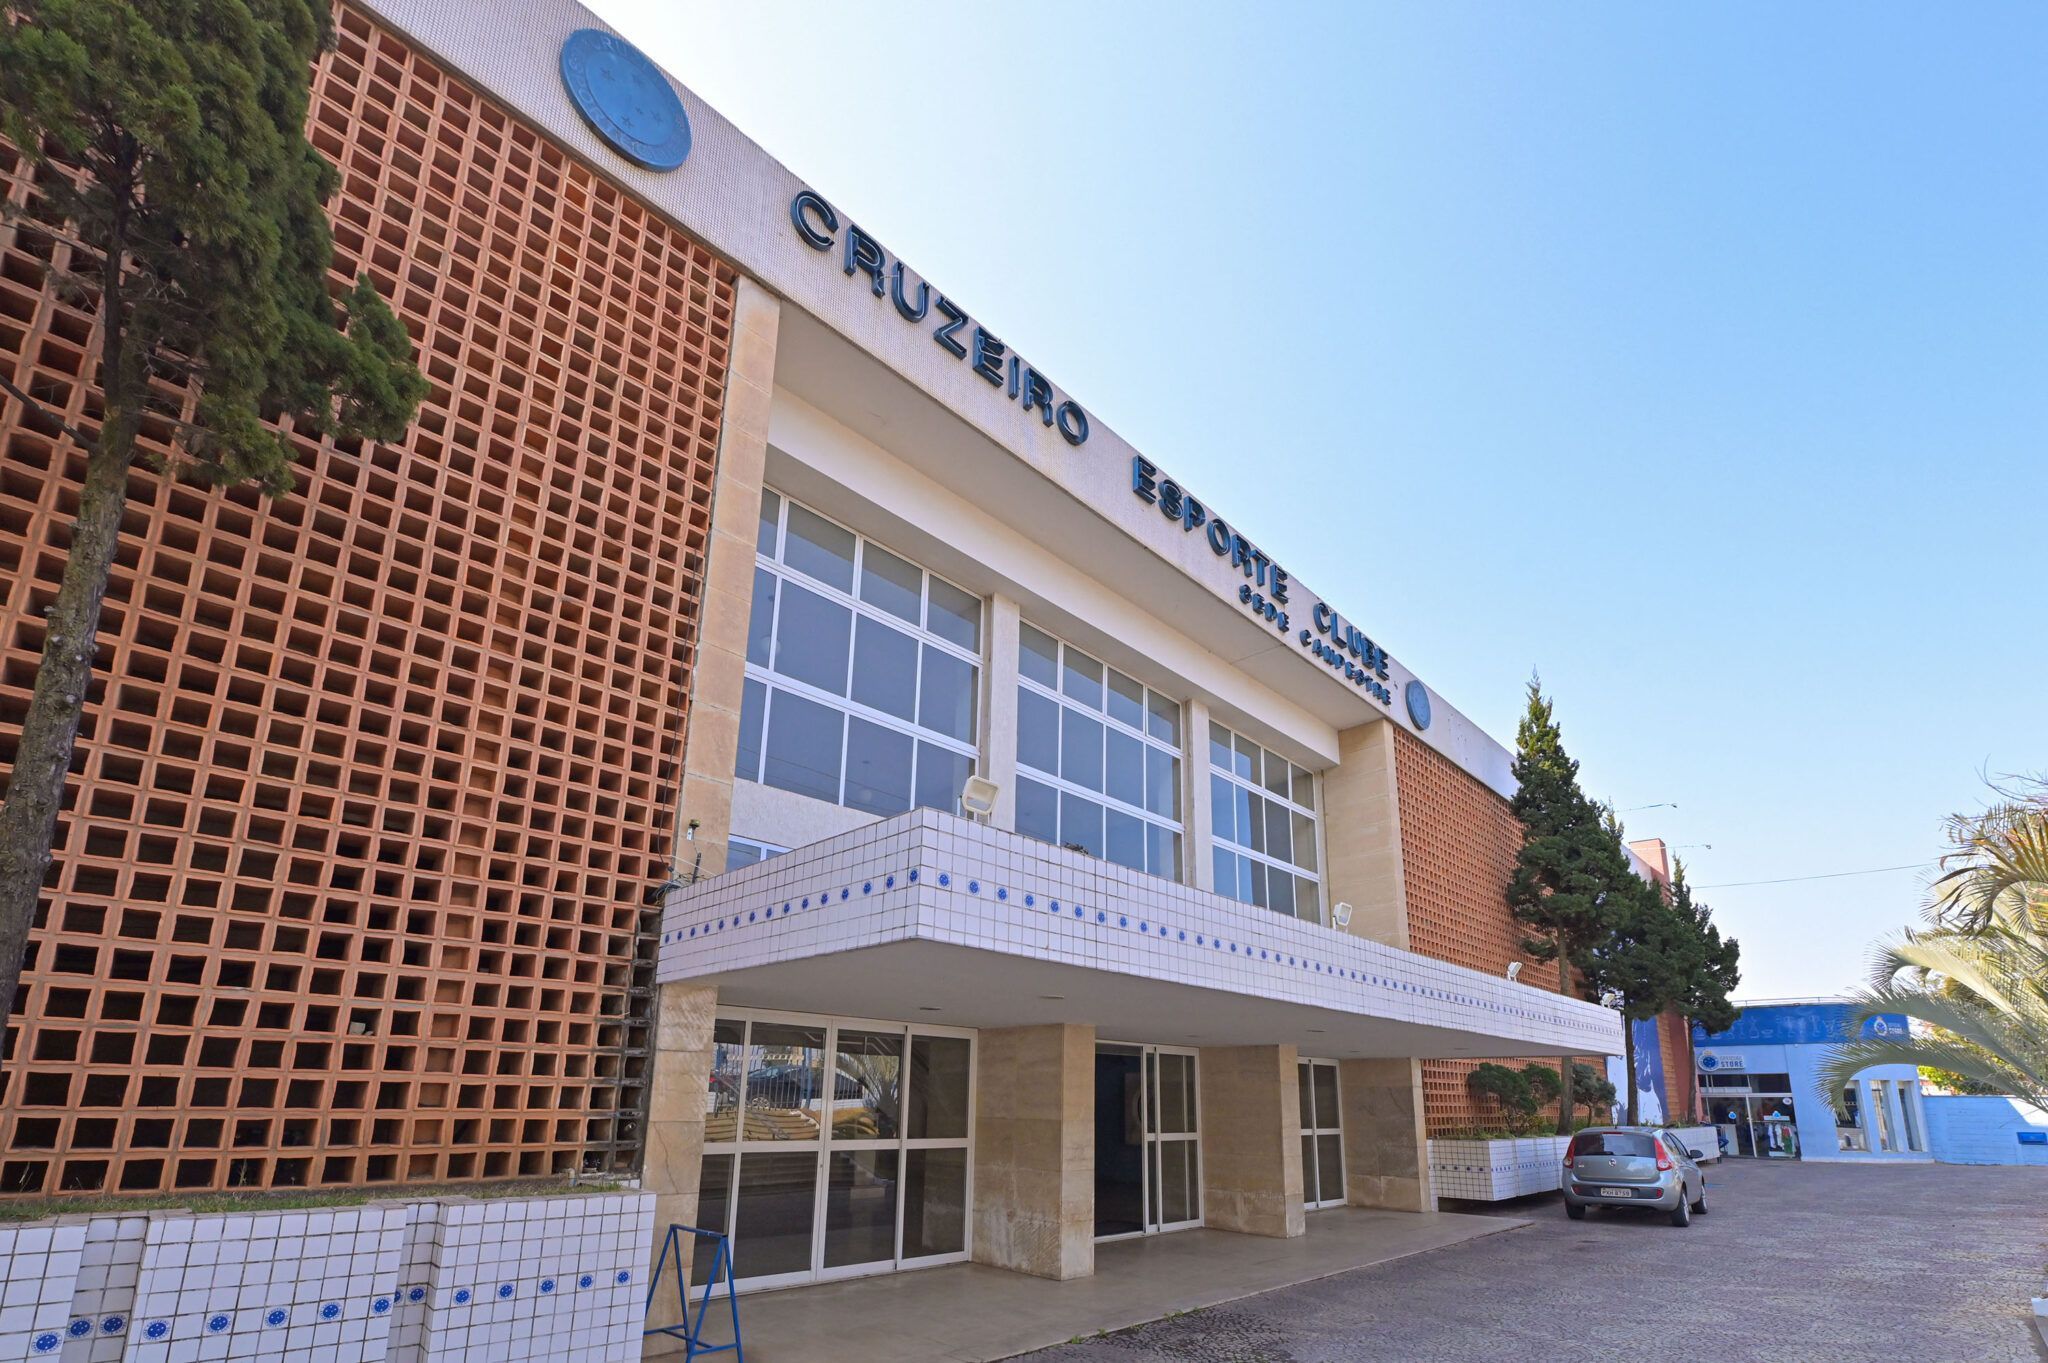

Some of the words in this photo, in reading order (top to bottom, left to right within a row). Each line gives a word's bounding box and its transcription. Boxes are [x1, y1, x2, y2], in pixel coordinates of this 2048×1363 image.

[790, 190, 1089, 446] CRUZEIRO
[1132, 455, 1289, 605] ESPORTE
[1313, 602, 1390, 682] CLUBE
[1239, 584, 1290, 633] SEDE
[1299, 629, 1392, 706] CAMPESTRE
[1720, 1060, 1744, 1068] STORE
